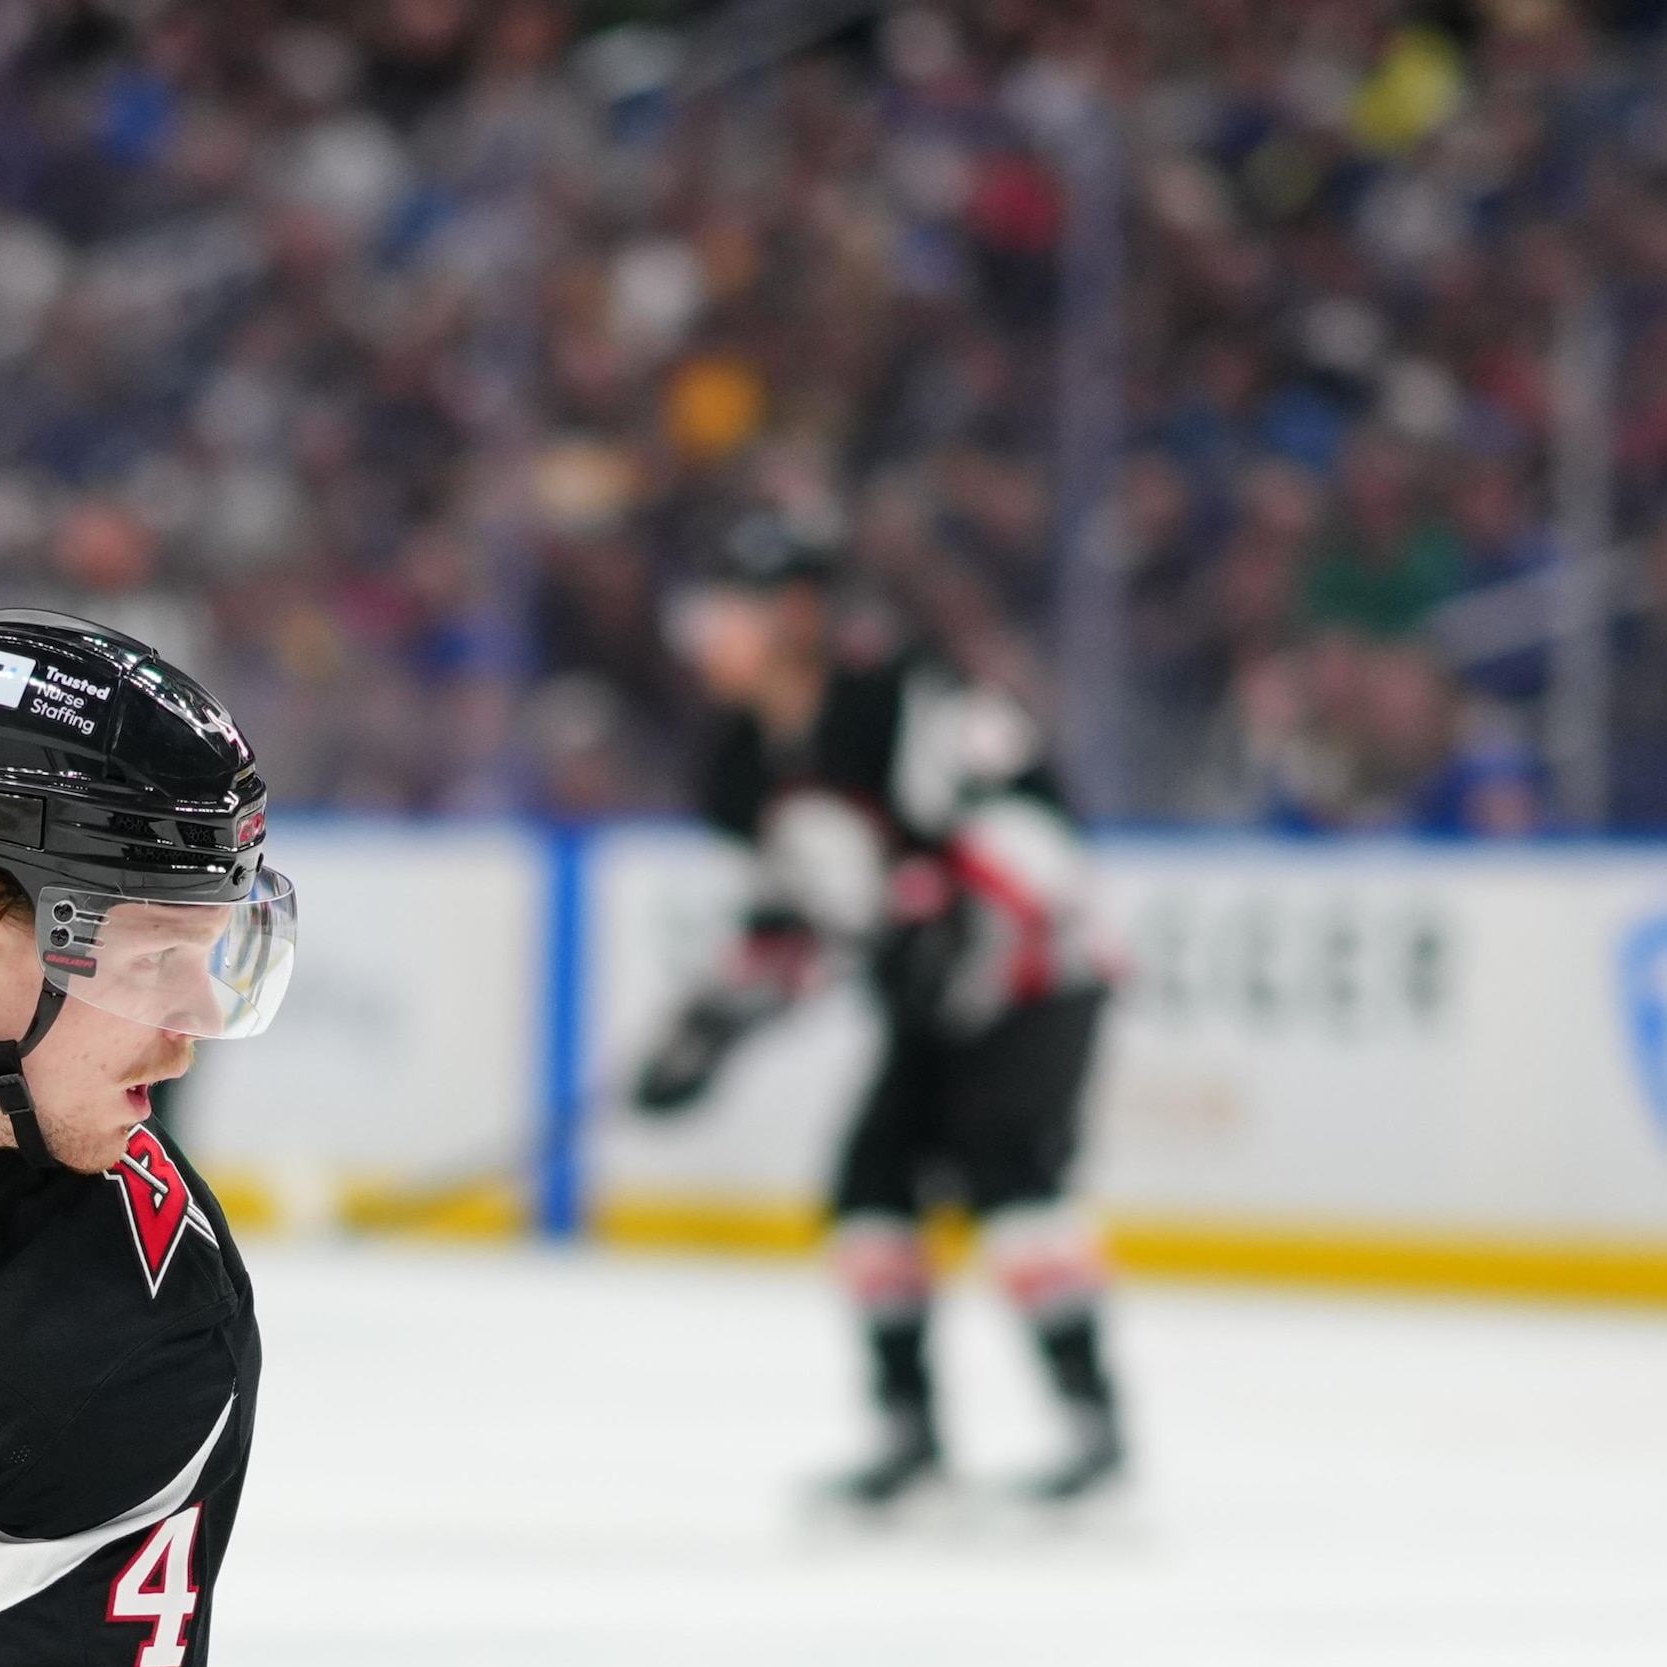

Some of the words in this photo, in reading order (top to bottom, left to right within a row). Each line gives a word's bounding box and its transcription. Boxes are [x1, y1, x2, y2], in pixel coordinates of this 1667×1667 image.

[36, 682, 85, 709] Nurse
[46, 665, 111, 701] Trusted
[30, 698, 95, 735] Staffing
